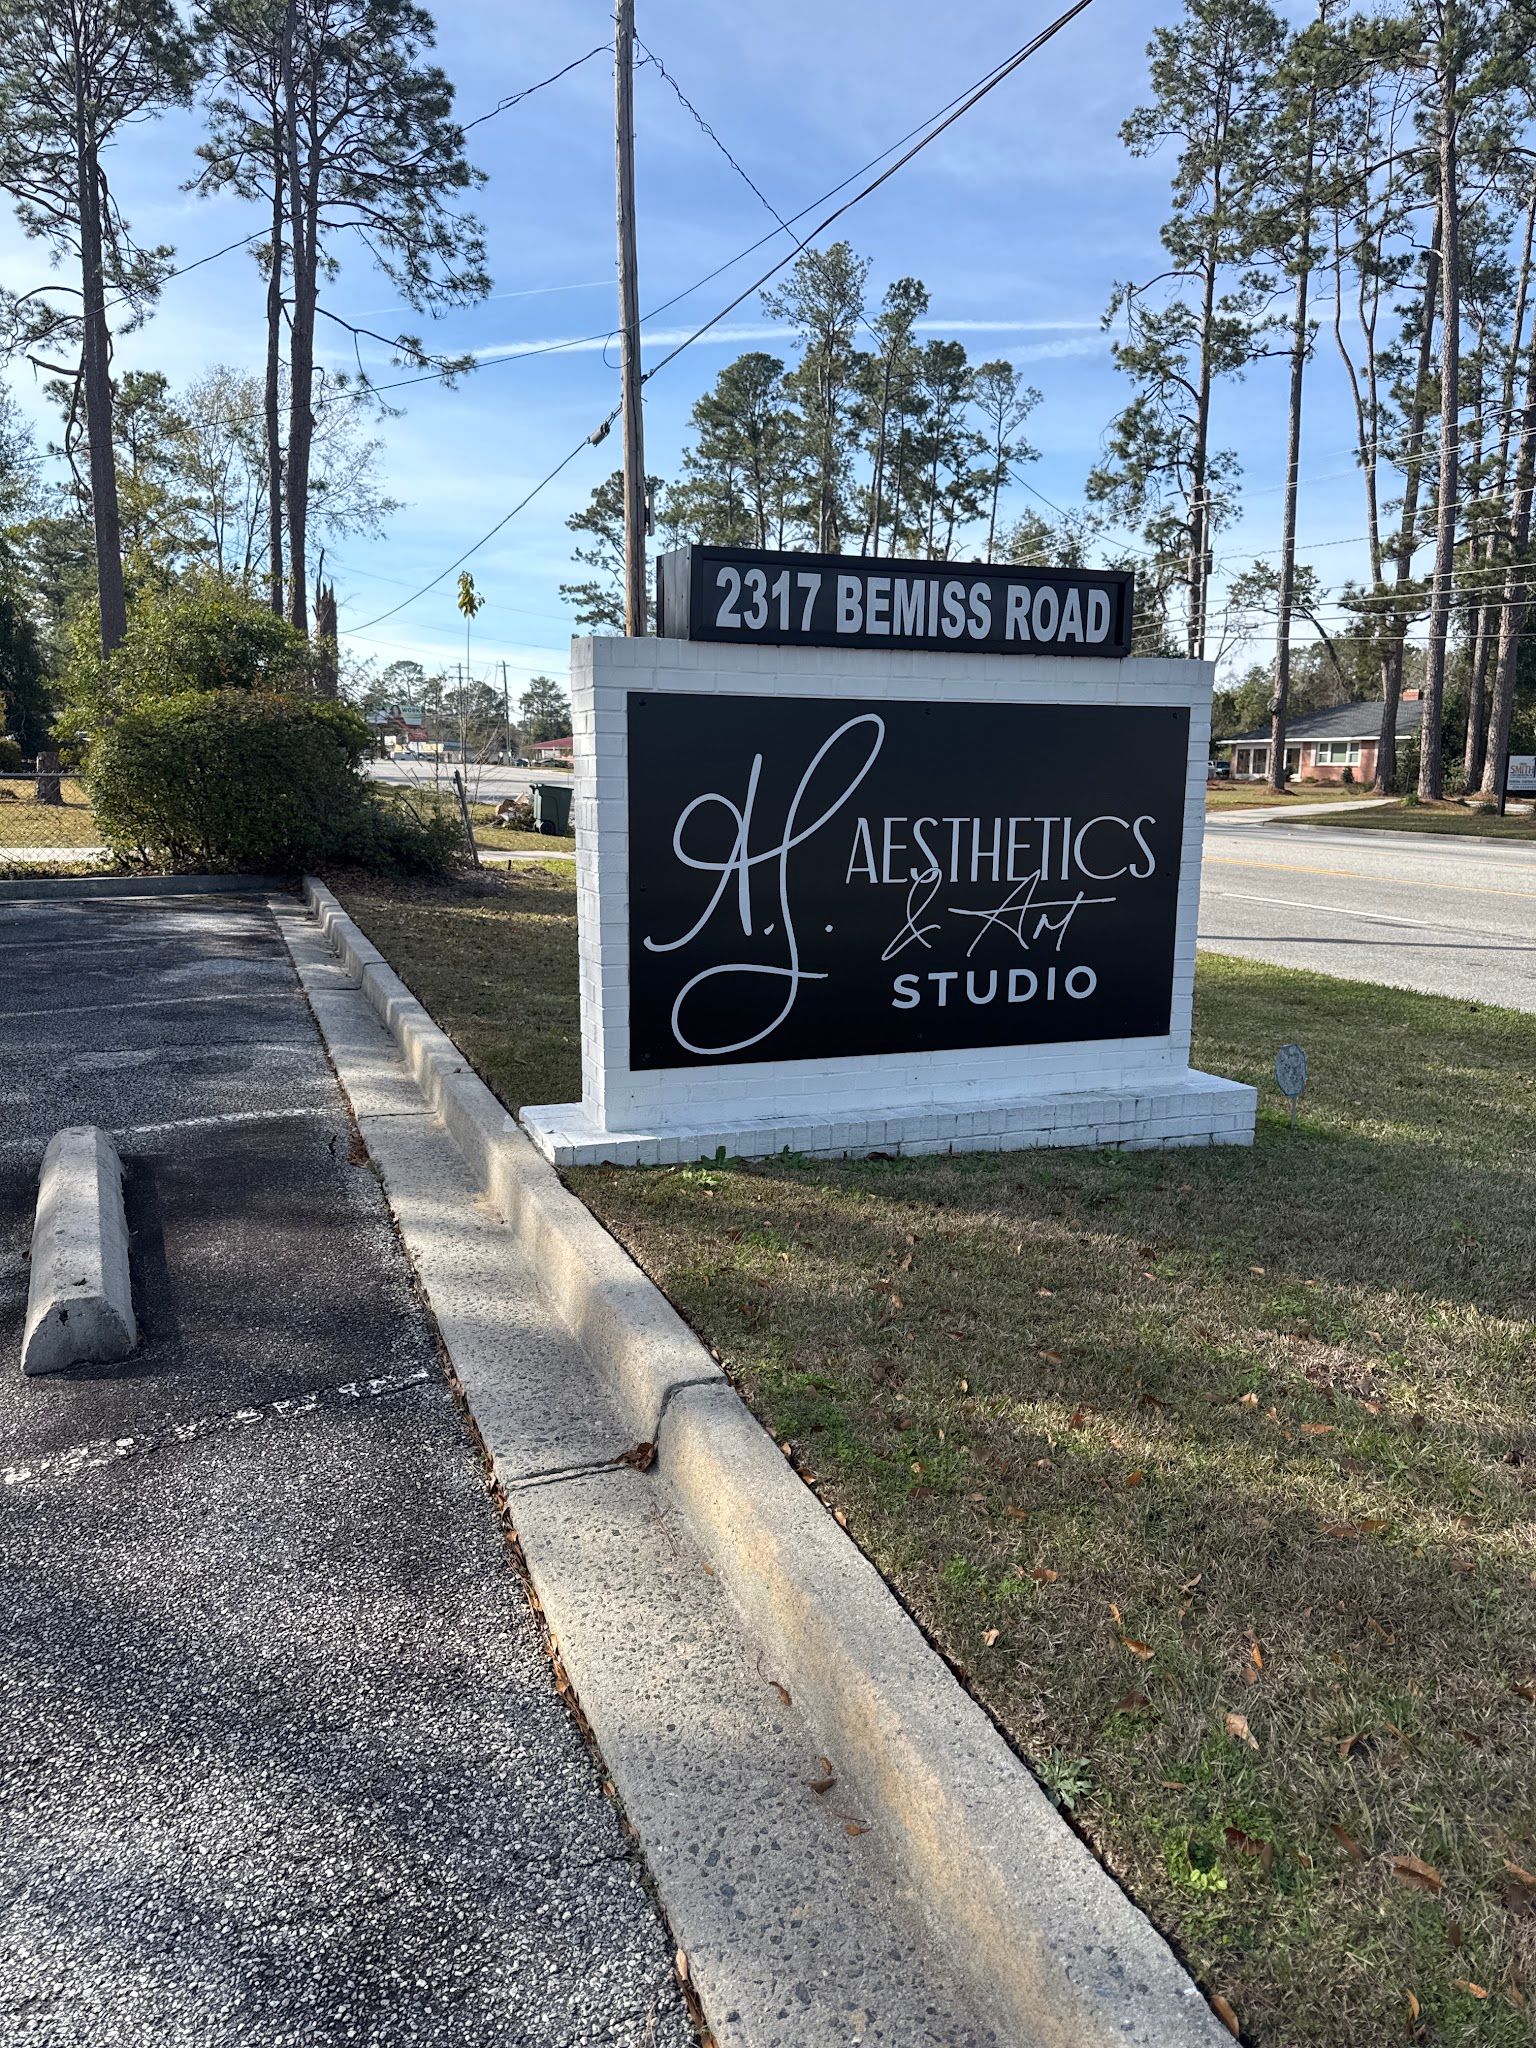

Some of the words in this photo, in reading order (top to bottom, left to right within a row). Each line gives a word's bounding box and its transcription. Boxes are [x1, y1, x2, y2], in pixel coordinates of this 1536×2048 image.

[715, 566, 822, 632] 2317
[836, 574, 992, 640] BEMISS
[1005, 584, 1111, 643] ROAD
[845, 815, 1157, 884] AESTHETICS
[881, 867, 943, 961] &
[947, 868, 1117, 958] Art
[891, 965, 1097, 1009] STUDIO
